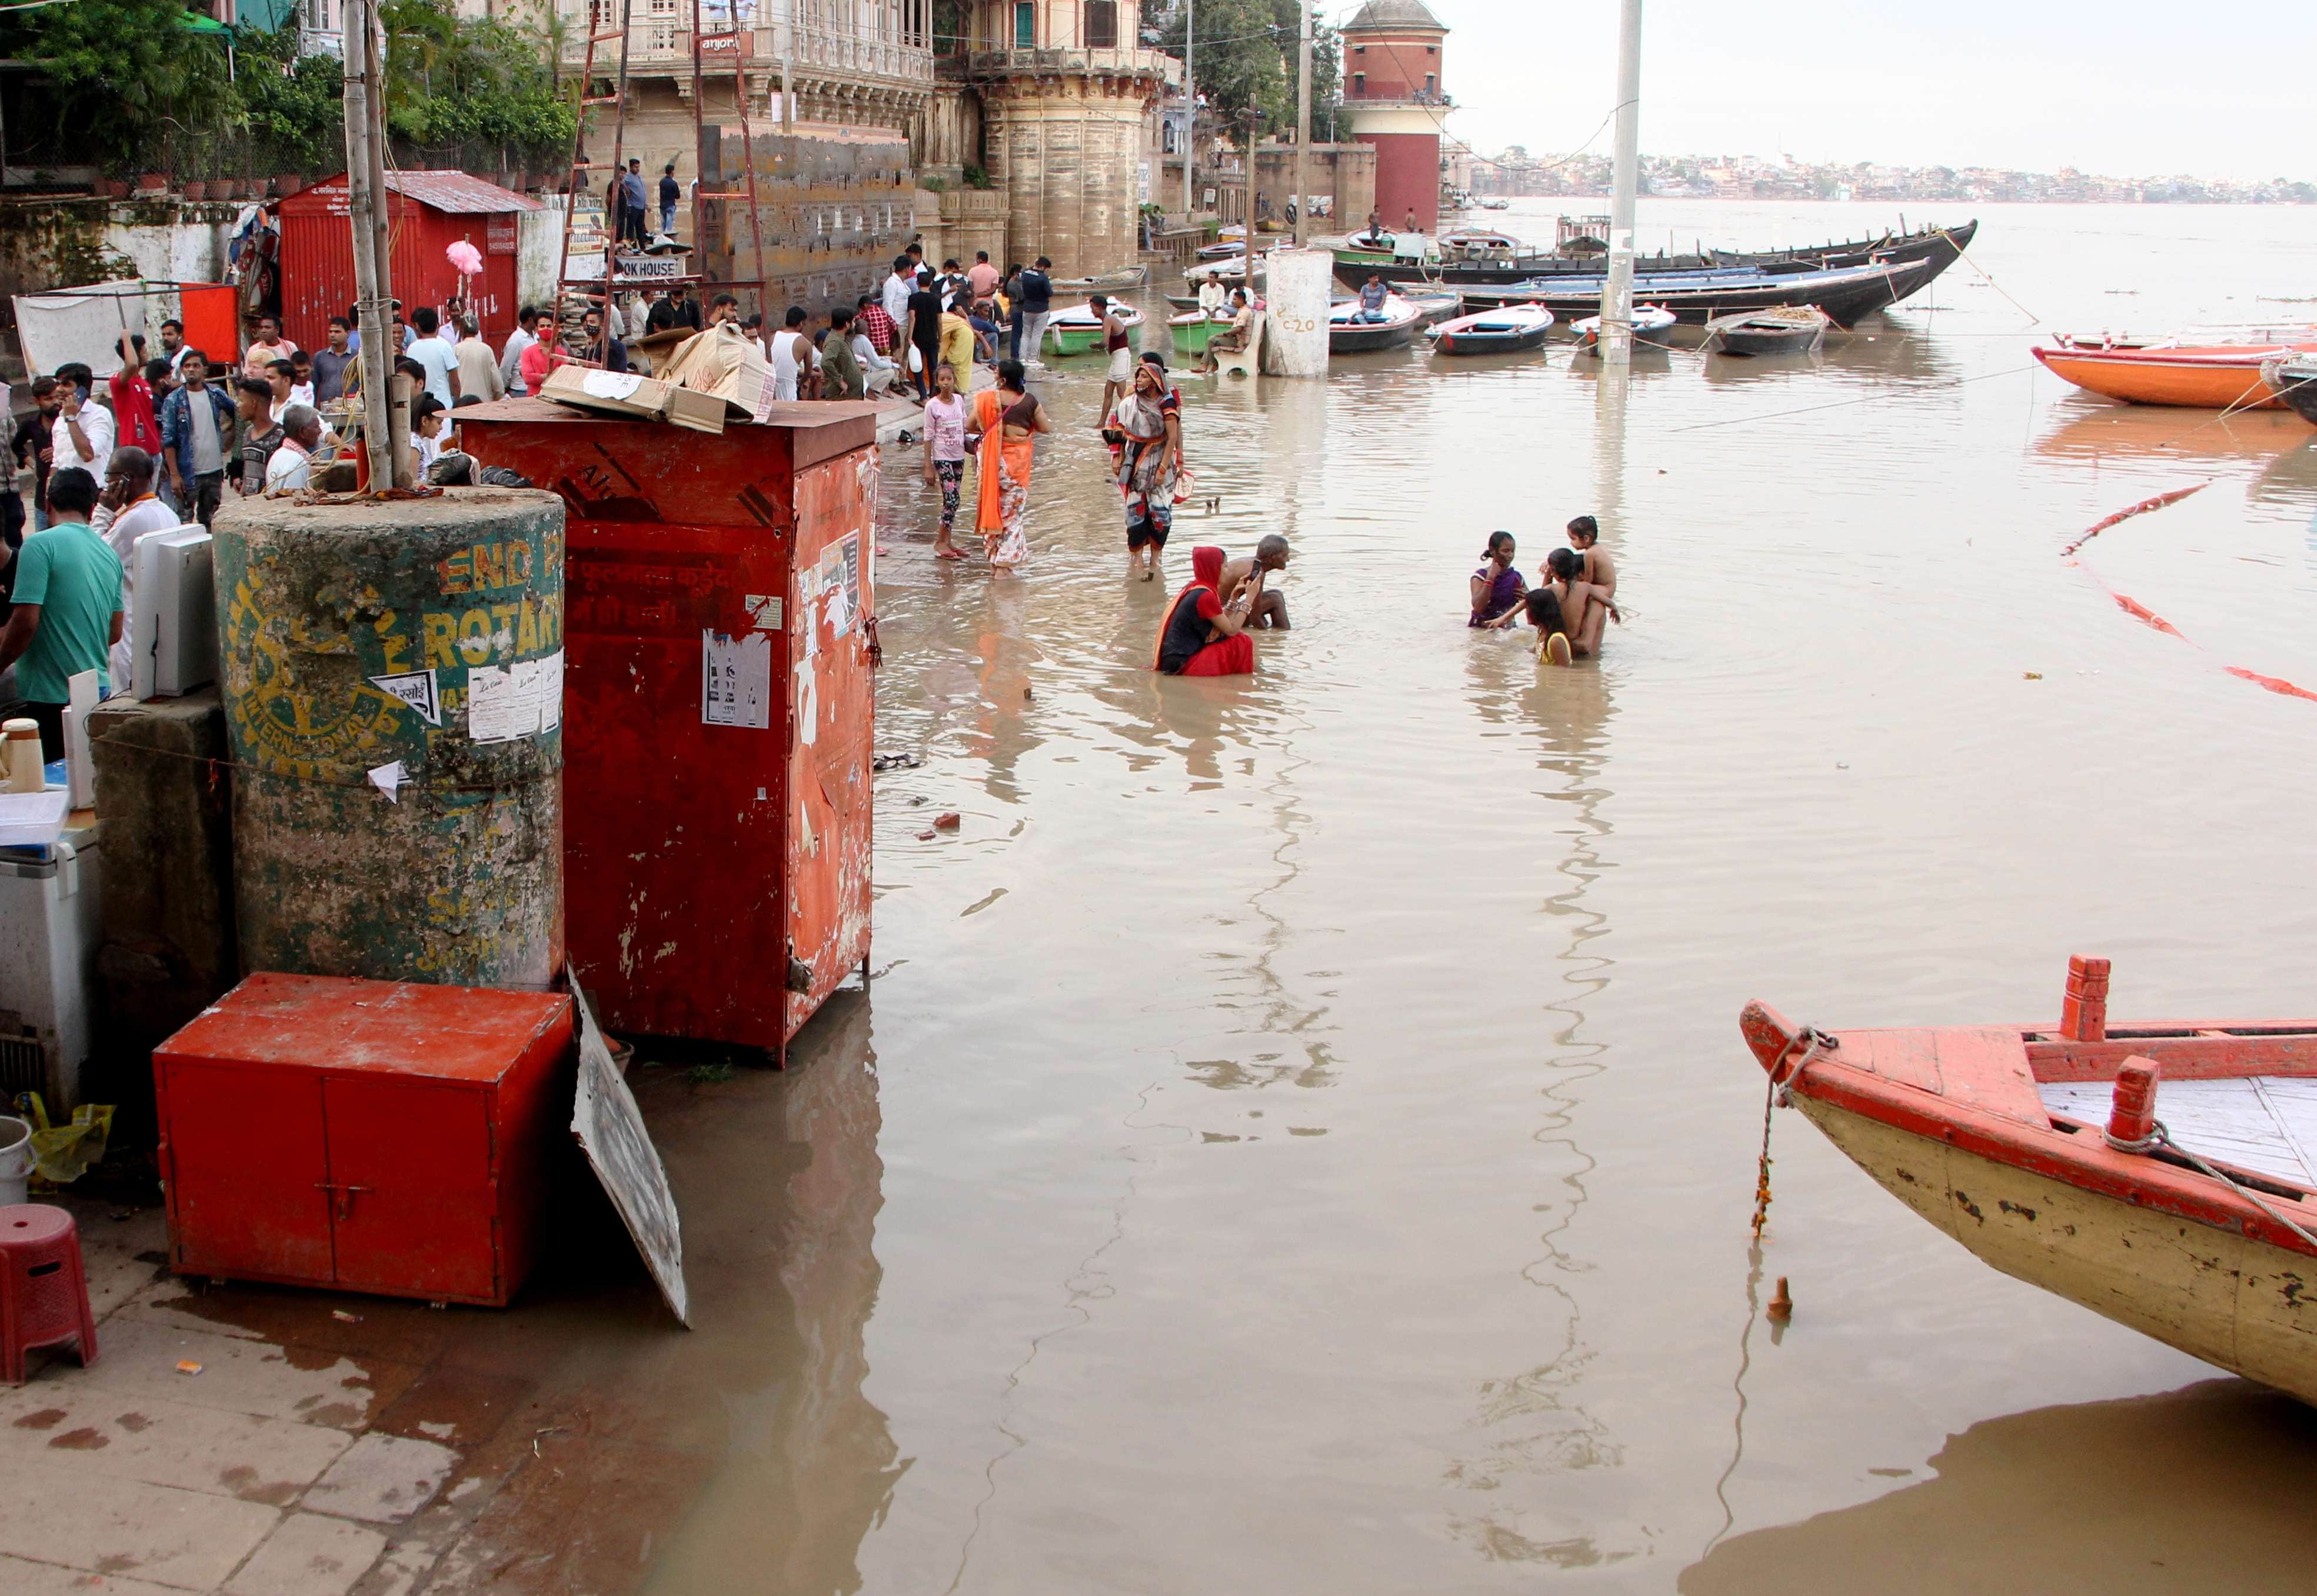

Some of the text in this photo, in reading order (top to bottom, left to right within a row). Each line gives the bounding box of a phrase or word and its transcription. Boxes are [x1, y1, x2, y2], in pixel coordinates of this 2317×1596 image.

[640, 262, 675, 276] HOUSE
[437, 540, 531, 595] END
[400, 682, 425, 699] रसोई
